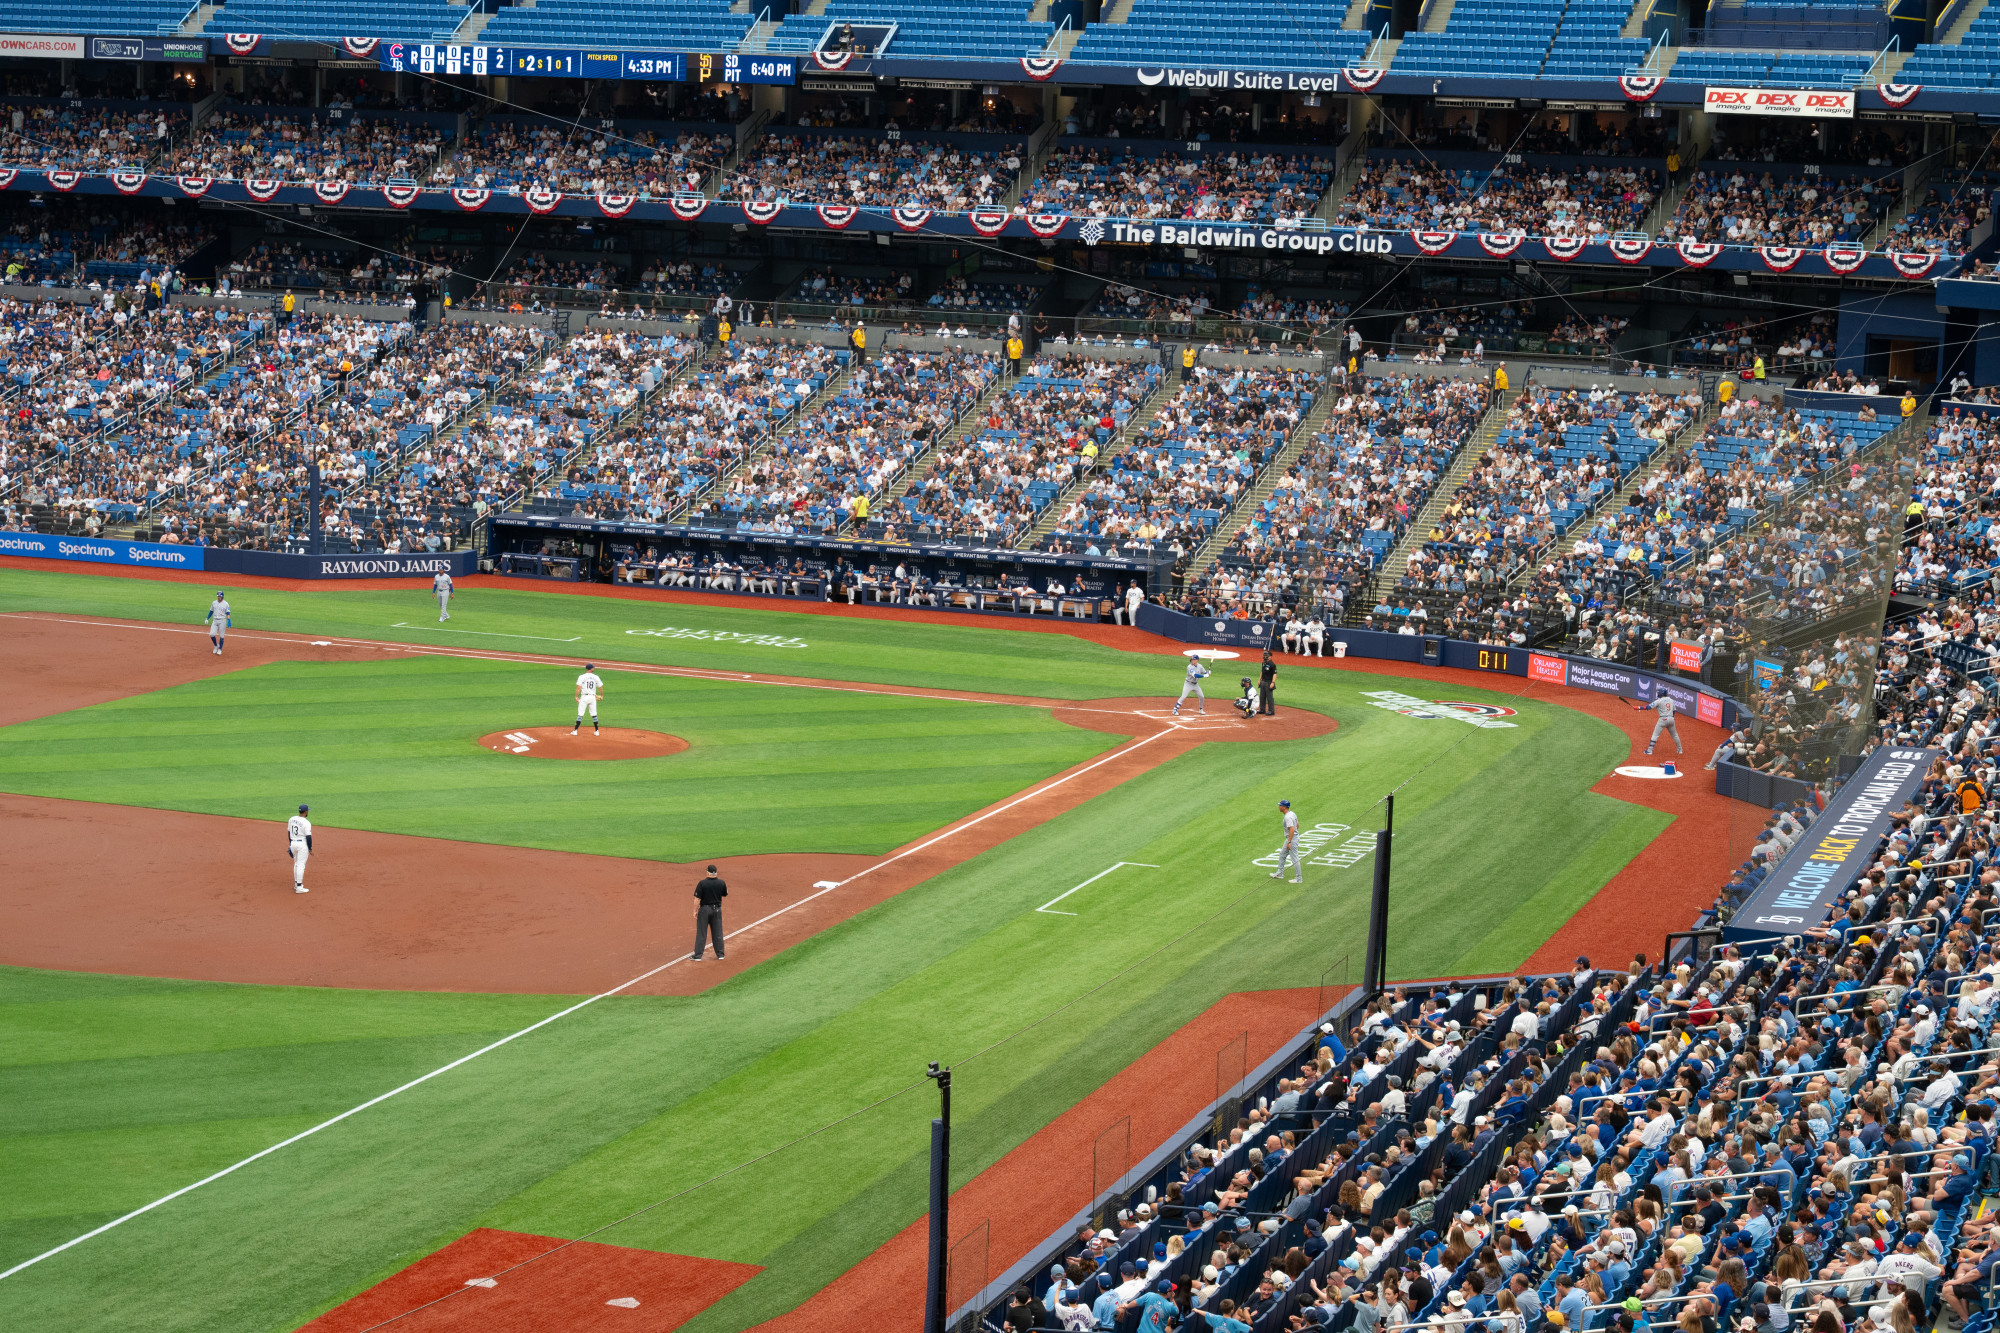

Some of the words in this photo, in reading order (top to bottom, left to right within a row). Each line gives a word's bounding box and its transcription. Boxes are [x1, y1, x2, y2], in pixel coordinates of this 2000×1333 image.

[0, 40, 76, 51] OWNCARS.COM
[163, 51, 203, 59] MORTGAGE
[411, 51, 418, 64] R
[438, 52, 445, 65] H
[463, 53, 471, 66] E
[496, 54, 504, 69] 2
[725, 55, 739, 68] SD
[519, 59, 525, 68] B
[527, 55, 535, 71] 2
[537, 59, 543, 69] S
[546, 56, 552, 71] 1
[566, 57, 572, 72] 1
[628, 59, 653, 73] 4:33
[656, 60, 672, 73] PM
[751, 62, 775, 76] 6:40
[777, 63, 791, 77] PM
[725, 69, 741, 82] PIT
[1168, 69, 1229, 88] Webull
[1234, 72, 1283, 89] Suite
[1289, 74, 1338, 91] Level
[1707, 92, 1749, 104] DEX
[1756, 93, 1799, 106] DEX
[1806, 95, 1849, 107] DEX
[330, 109, 342, 118] 216
[1716, 103, 1751, 111] imaging
[1765, 104, 1801, 112] imaging
[1815, 106, 1851, 114] imaging
[887, 130, 900, 140] 212
[1187, 142, 1201, 151] 210
[1505, 154, 1522, 164] 208
[1804, 165, 1820, 175] 206
[1112, 223, 1155, 244] The
[1160, 226, 1255, 248] Baldwin
[1261, 231, 1333, 255] Group
[1339, 233, 1393, 254] Club
[59, 541, 112, 556] Spectrum
[129, 547, 182, 562] Spectrum
[321, 560, 400, 574] RAYMOND
[401, 560, 452, 573] JAMES
[1533, 657, 1562, 670] ORLANDO
[1675, 657, 1700, 669] HEALTH
[1536, 666, 1560, 677] HEALTH
[1572, 665, 1591, 676] Major
[1591, 668, 1614, 681] League
[1615, 673, 1630, 683] Care
[586, 680, 594, 690] 18
[1571, 675, 1589, 685] Made
[1590, 678, 1619, 691] Personal.
[1665, 702, 1671, 712] 9
[1700, 698, 1720, 710] ORLANDO
[1874, 761, 1916, 783] FIELD
[1839, 783, 1902, 824] TROPICANA
[291, 825, 299, 836] 13
[1829, 823, 1868, 837] TO
[1810, 836, 1860, 862] BACK
[1771, 861, 1841, 908] WELCOME
